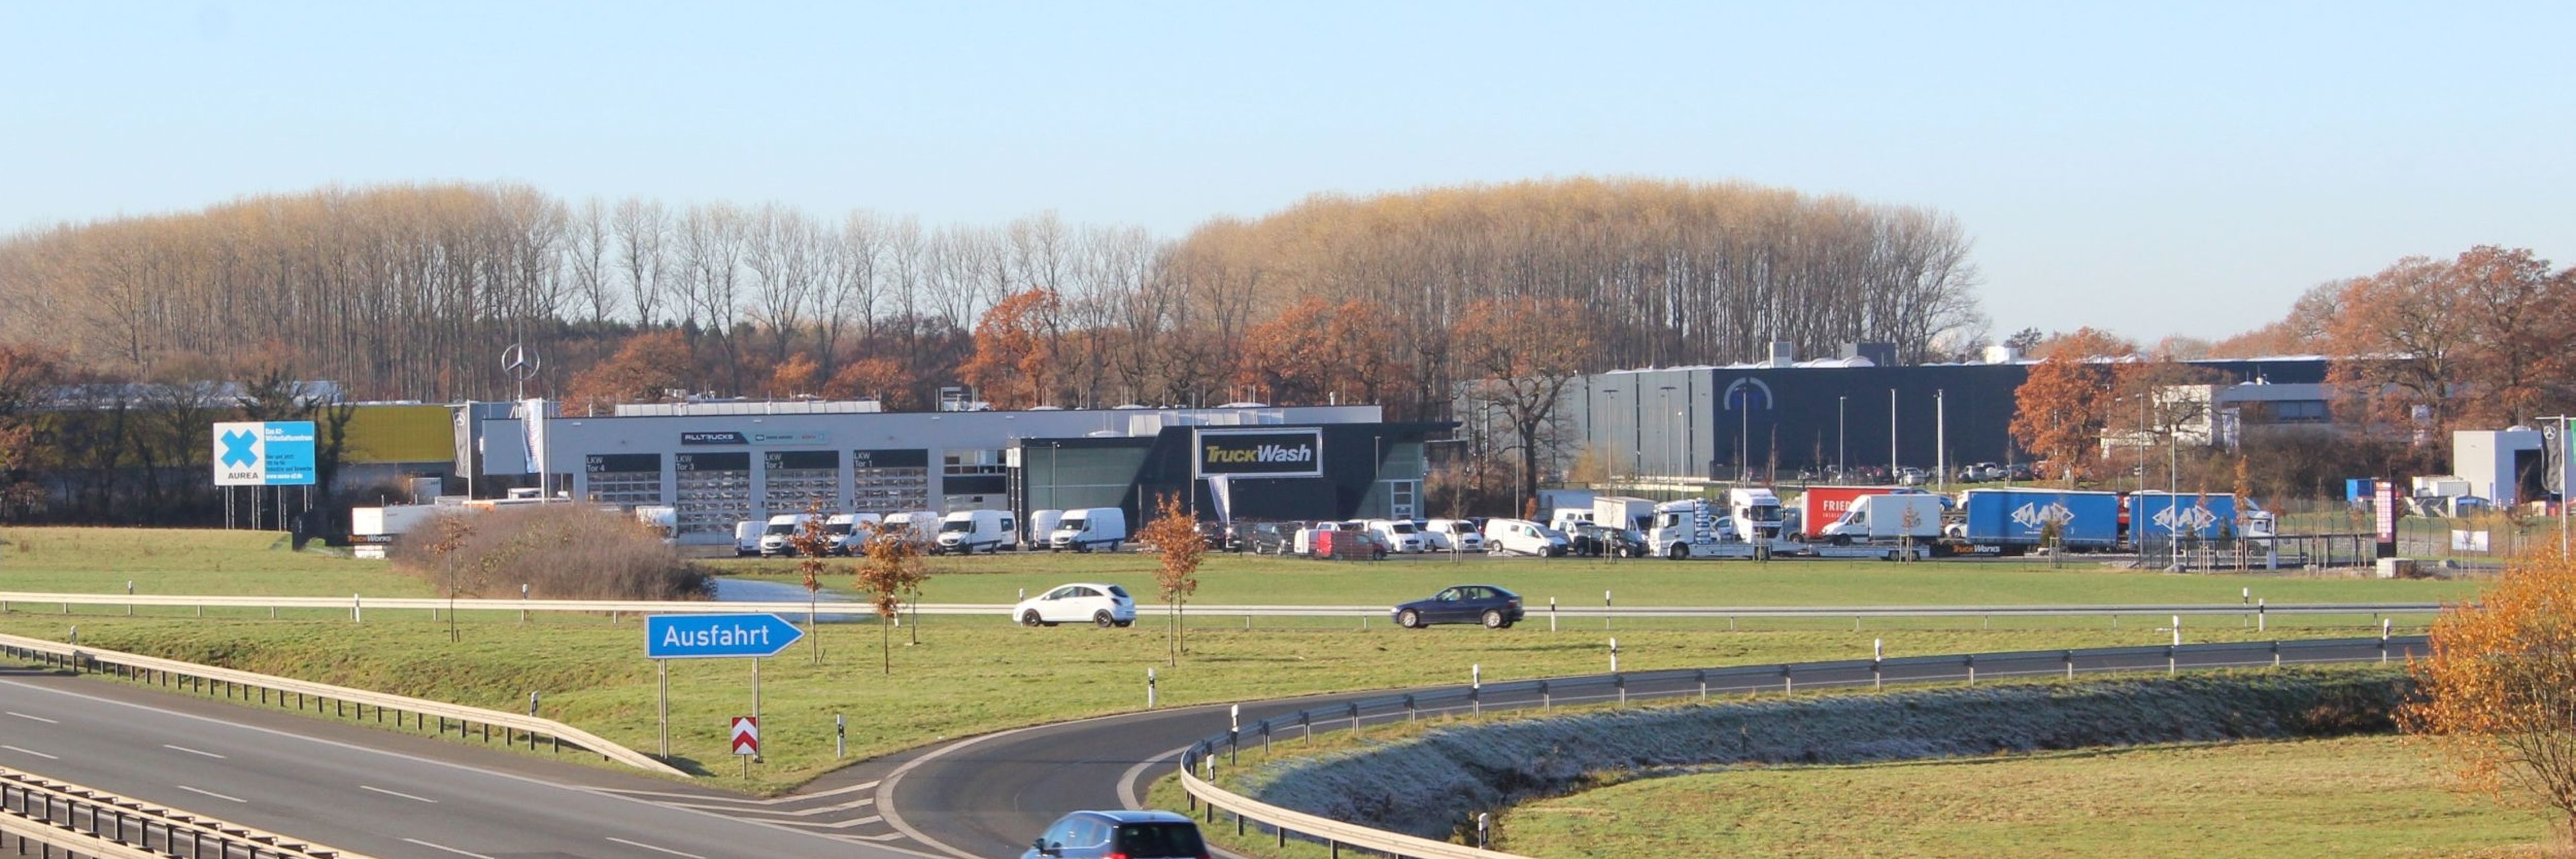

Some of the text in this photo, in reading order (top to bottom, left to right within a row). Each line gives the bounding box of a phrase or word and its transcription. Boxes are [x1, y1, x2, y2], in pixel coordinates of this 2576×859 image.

[1206, 444, 1311, 463] TruckWash
[587, 464, 598, 472] Tor
[663, 624, 769, 646] Ausfahrt
